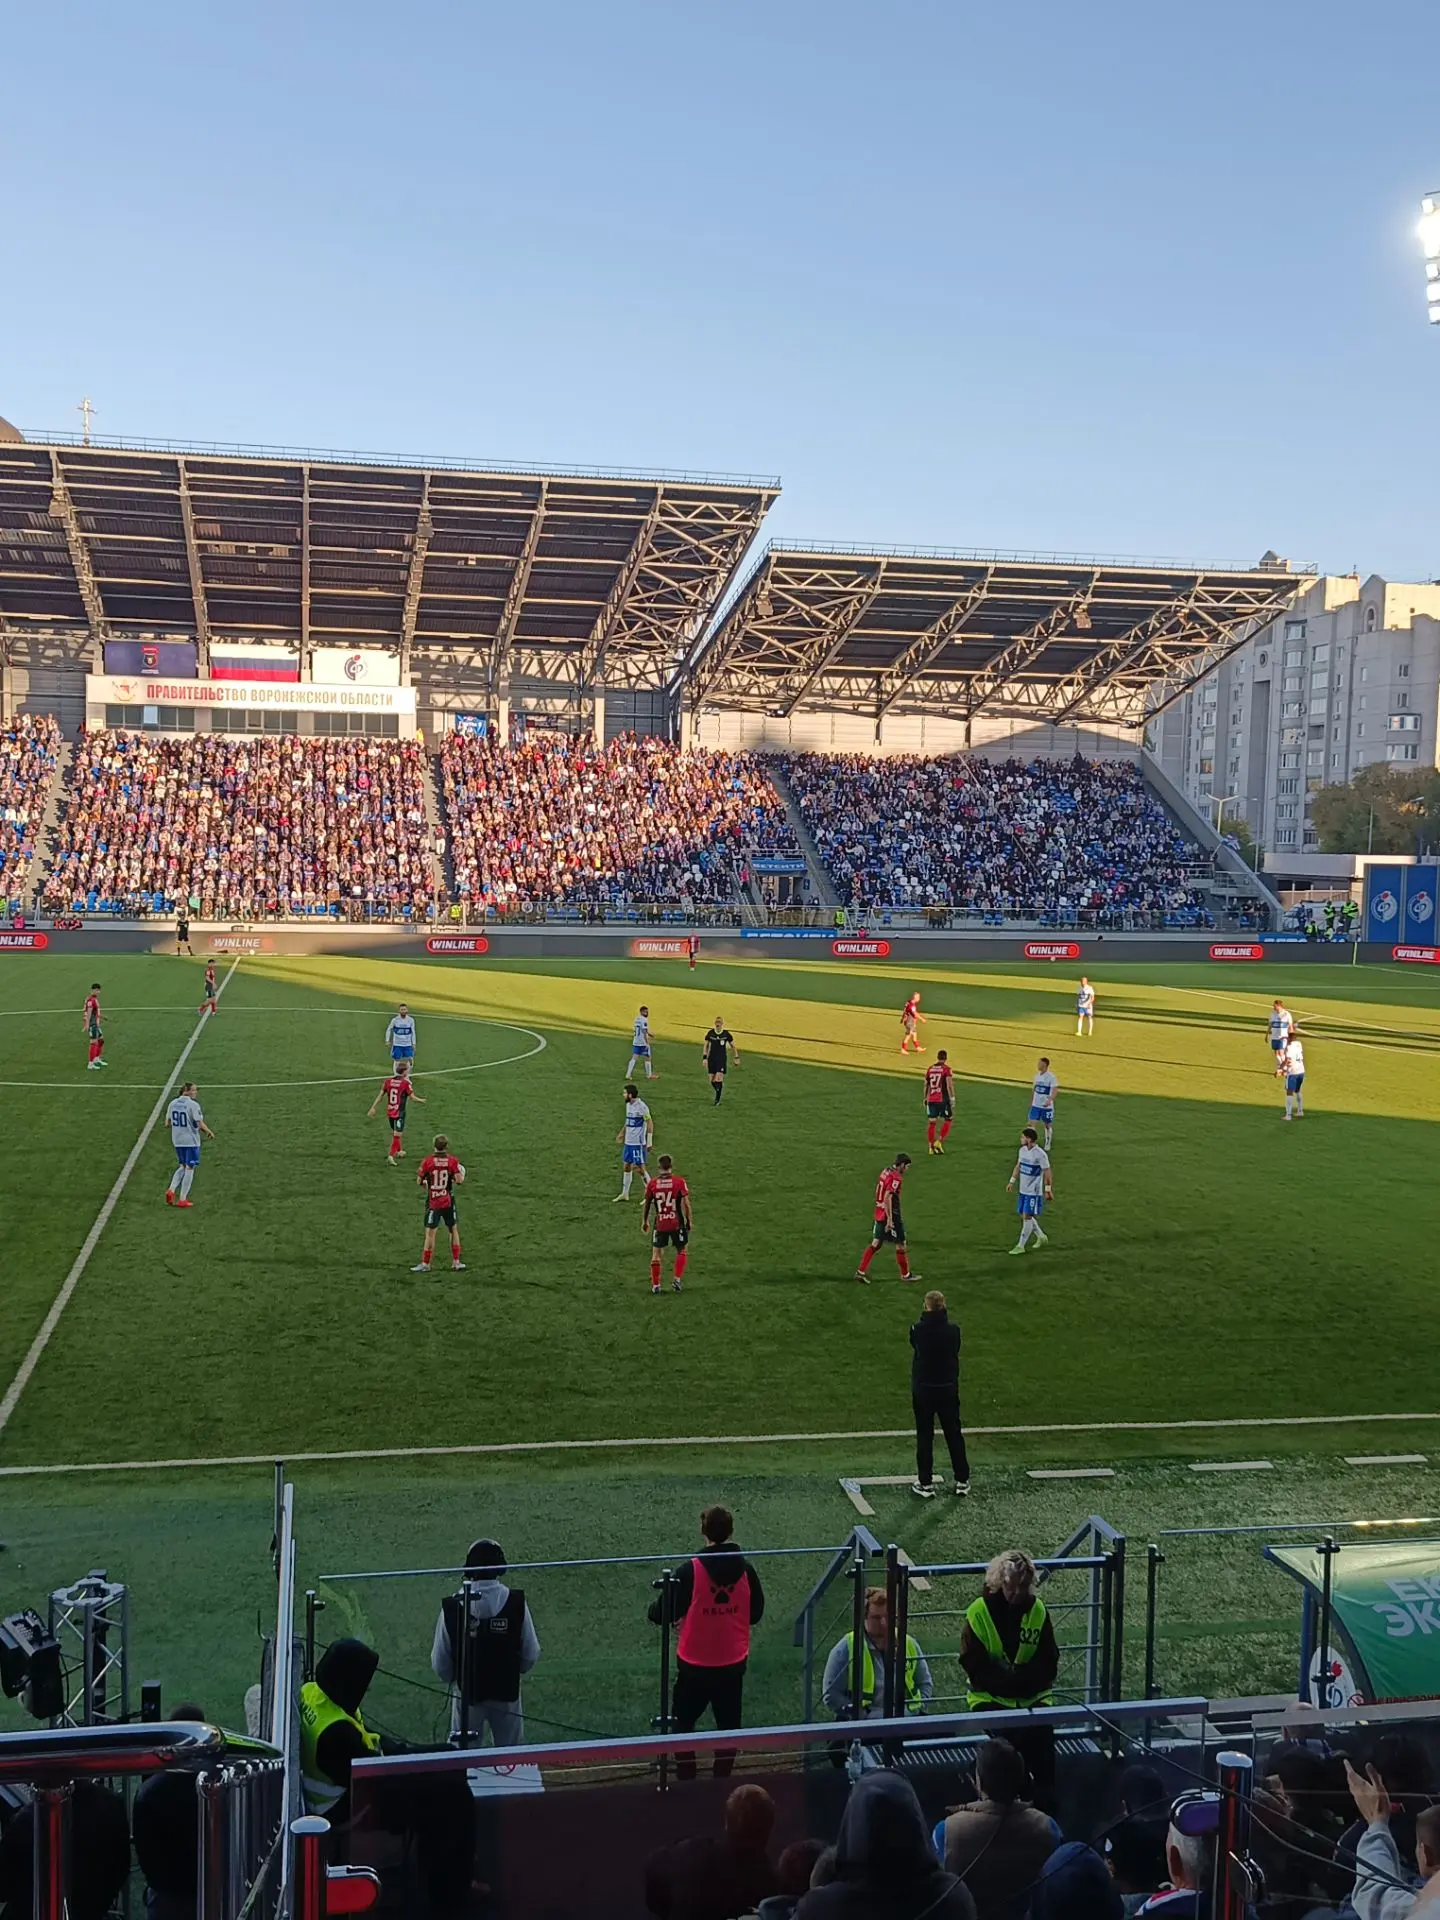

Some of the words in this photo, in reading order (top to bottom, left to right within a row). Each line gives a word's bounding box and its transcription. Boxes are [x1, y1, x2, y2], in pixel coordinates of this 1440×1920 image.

[147, 684, 247, 701] ПРАВИТЕЛЬСТВО
[340, 692, 393, 705] ОБЛАСТИ
[214, 938, 261, 948] WINLINE
[432, 940, 476, 949] WINLINE
[639, 942, 681, 952] WINLINE
[837, 943, 878, 953] WINLINE
[1029, 946, 1068, 955] WINLINE
[1214, 947, 1252, 956] WINLINE
[1397, 949, 1435, 960] WINLINE
[930, 1073, 941, 1088] 27
[390, 1088, 398, 1105] 6
[172, 1111, 187, 1127] 90
[431, 1169, 449, 1189] 18
[655, 1190, 677, 1212] 24
[1372, 1601, 1440, 1637] ЭК
